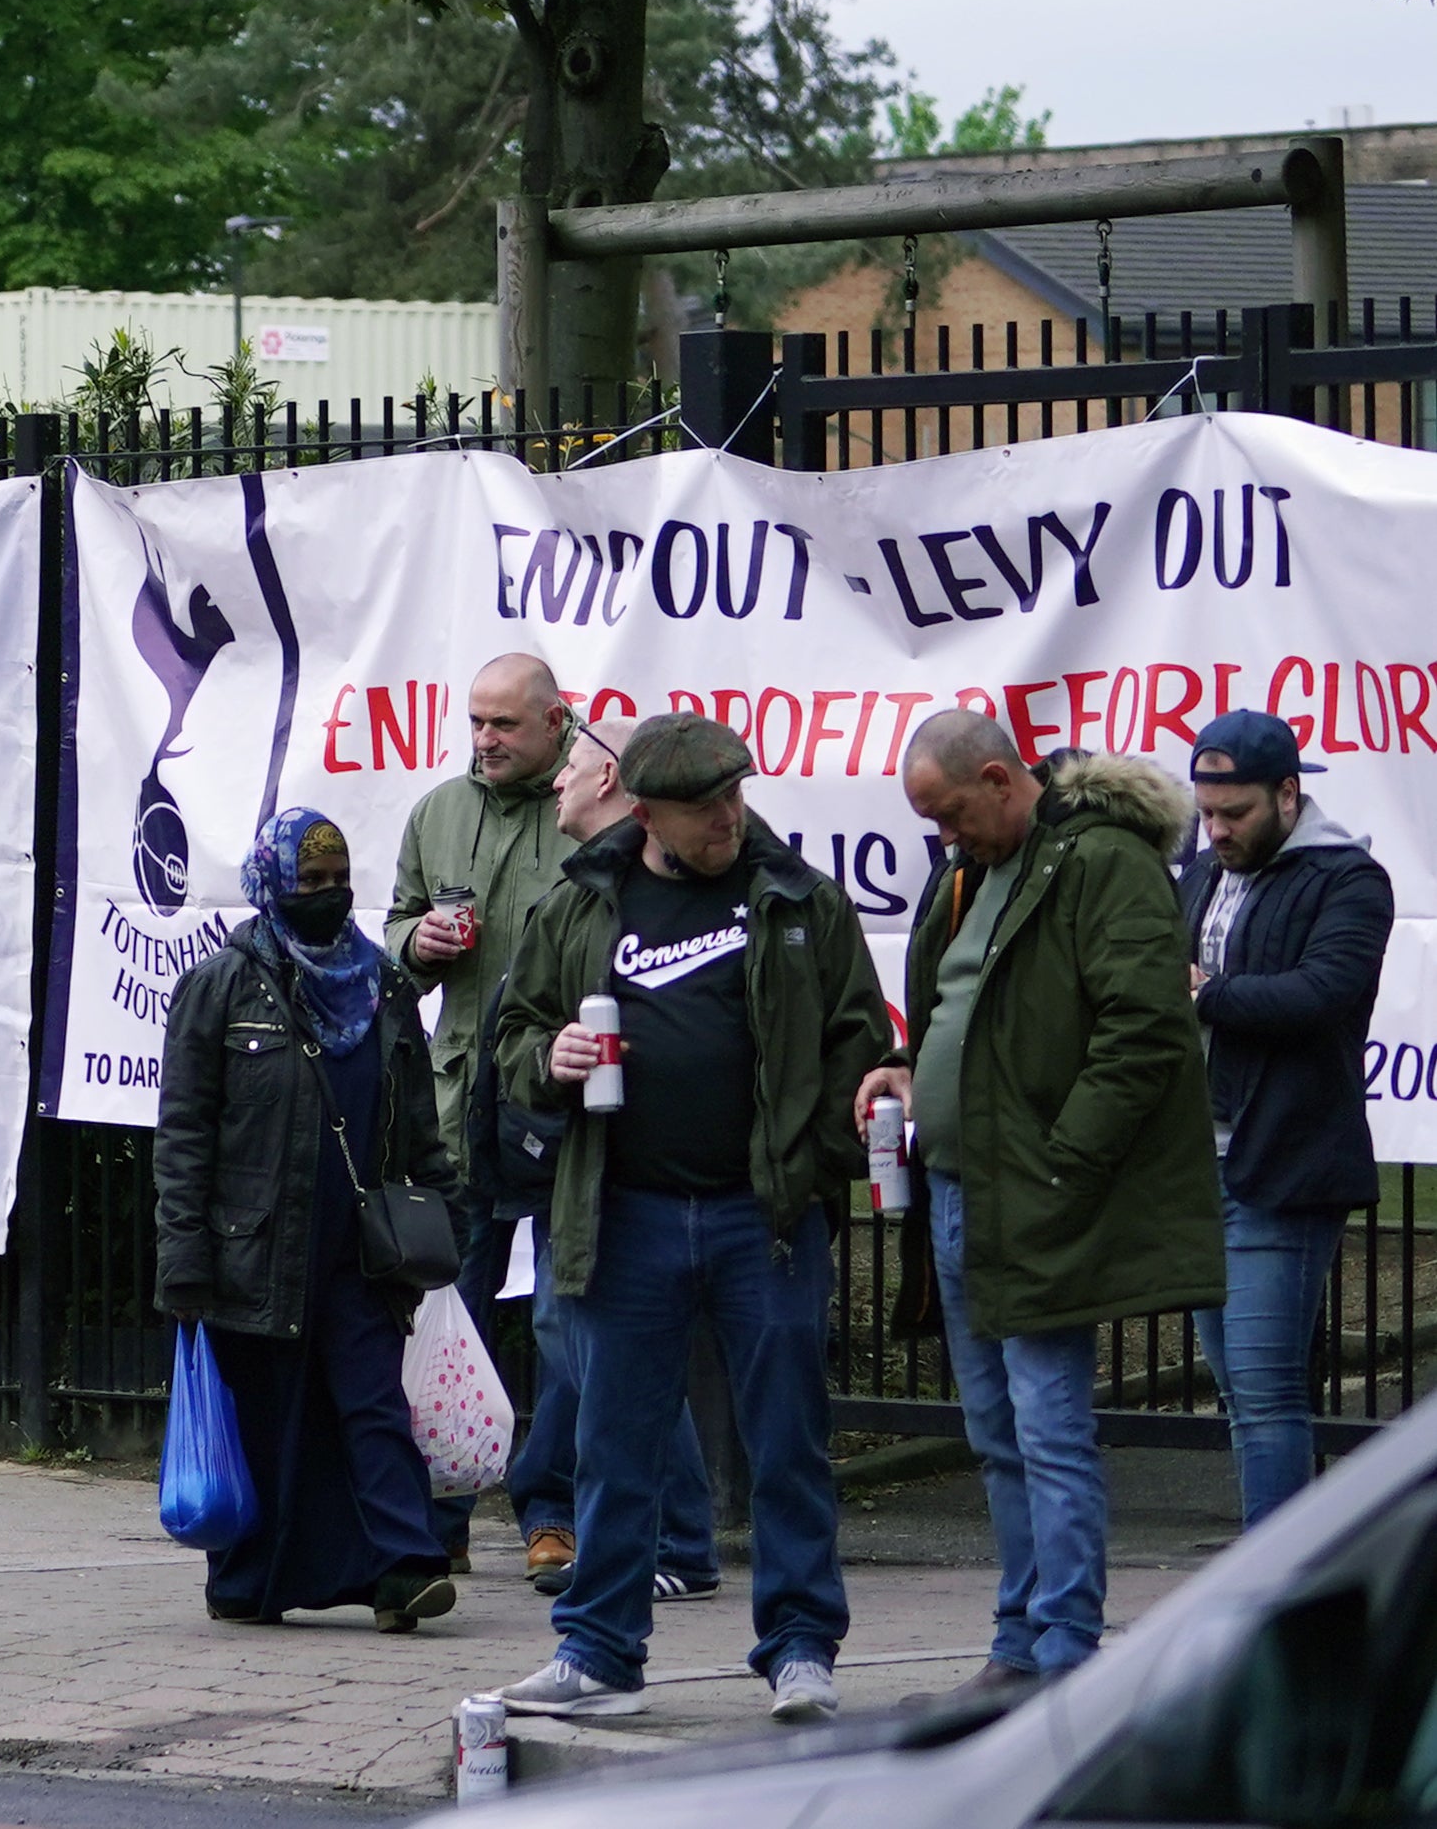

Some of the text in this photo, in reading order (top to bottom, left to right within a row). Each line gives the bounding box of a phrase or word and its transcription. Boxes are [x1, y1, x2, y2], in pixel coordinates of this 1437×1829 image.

[492, 522, 644, 627] ENIC
[650, 520, 813, 621] OUT
[877, 502, 1112, 628] LEVY
[1154, 483, 1291, 590] OUT
[321, 680, 449, 774] ENI
[100, 898, 230, 978] TOTTENHAM
[613, 925, 749, 977] Converse
[83, 1052, 161, 1089] TO DAR
